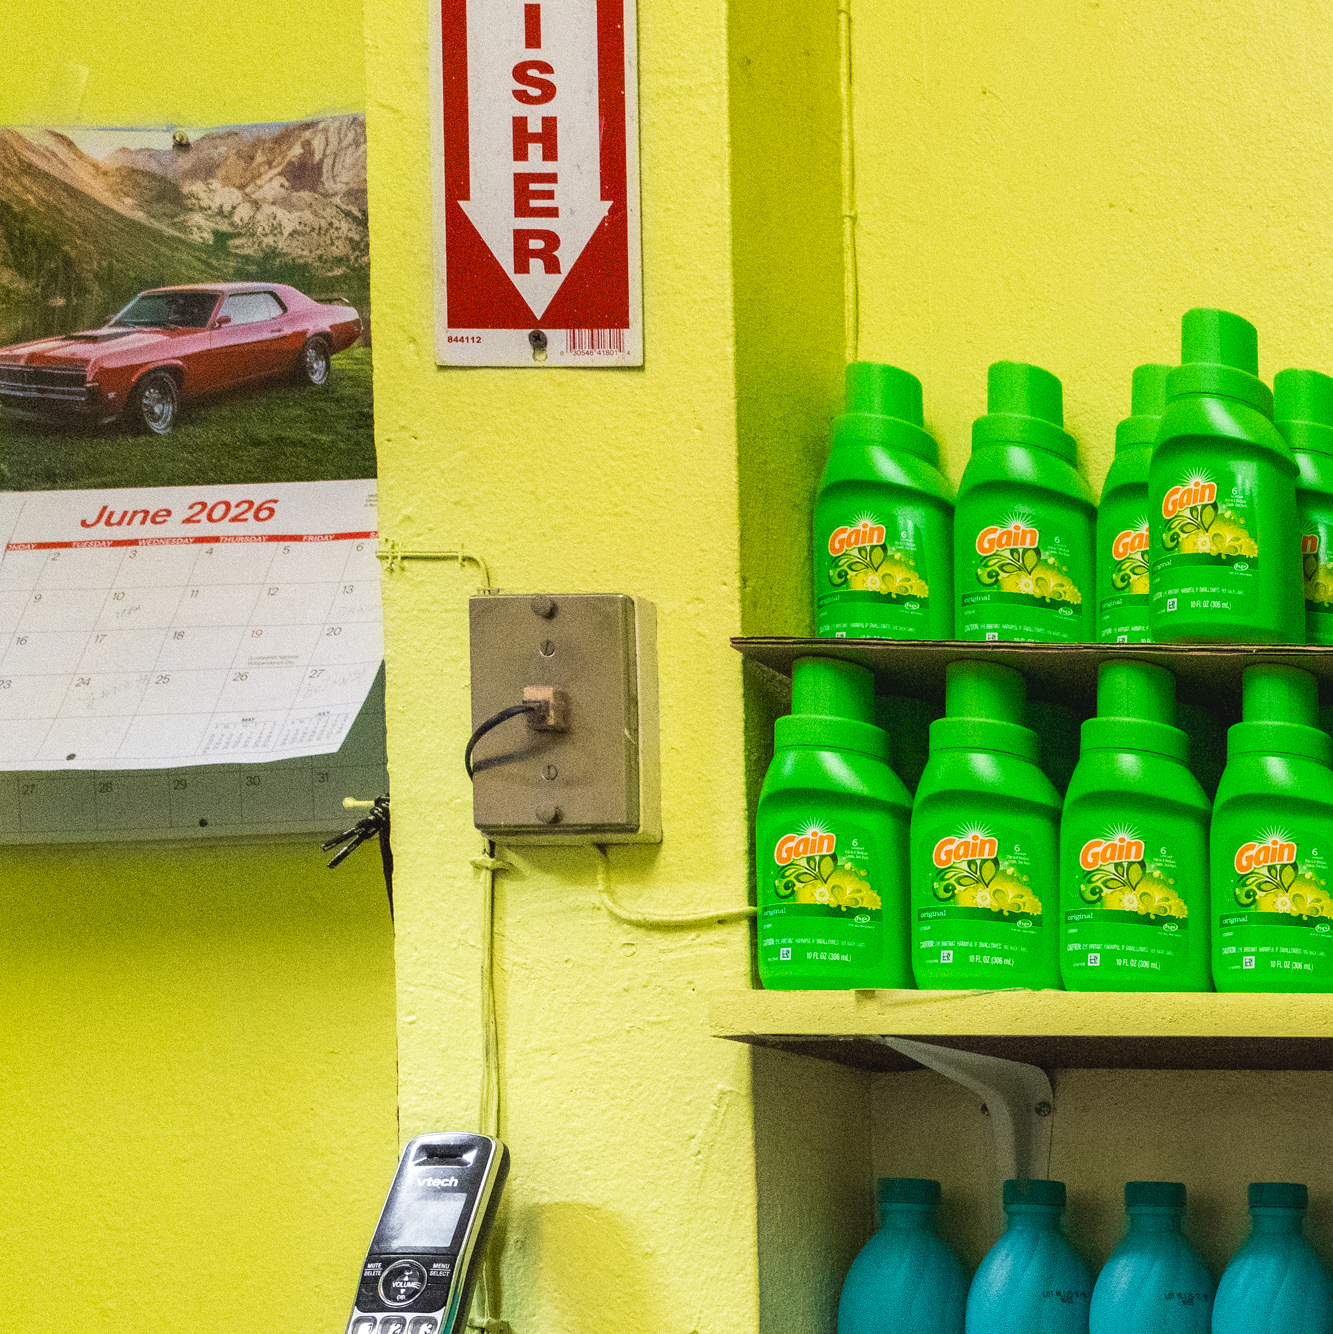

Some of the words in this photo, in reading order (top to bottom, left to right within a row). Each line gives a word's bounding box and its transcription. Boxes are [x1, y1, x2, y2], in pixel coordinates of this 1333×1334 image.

[447, 336, 482, 344] 844112
[1162, 480, 1218, 519] Gain
[80, 505, 172, 528] June
[182, 499, 279, 524] 2026
[71, 539, 112, 548] TUESDAY
[138, 537, 195, 546] WEDNESDAY
[219, 535, 268, 543] THURSDAY
[302, 534, 335, 542] FRIDAY
[828, 522, 886, 556] Gain
[172, 631, 184, 640] 18
[251, 629, 263, 638] 19
[326, 627, 342, 636] 20
[155, 674, 171, 684] 25
[232, 672, 248, 682] 26
[309, 669, 324, 679] 27
[774, 831, 836, 866] Gain
[933, 834, 998, 868] Gain
[1234, 839, 1298, 875] Gain
[920, 909, 946, 918] original
[417, 1176, 458, 1187] vtech
